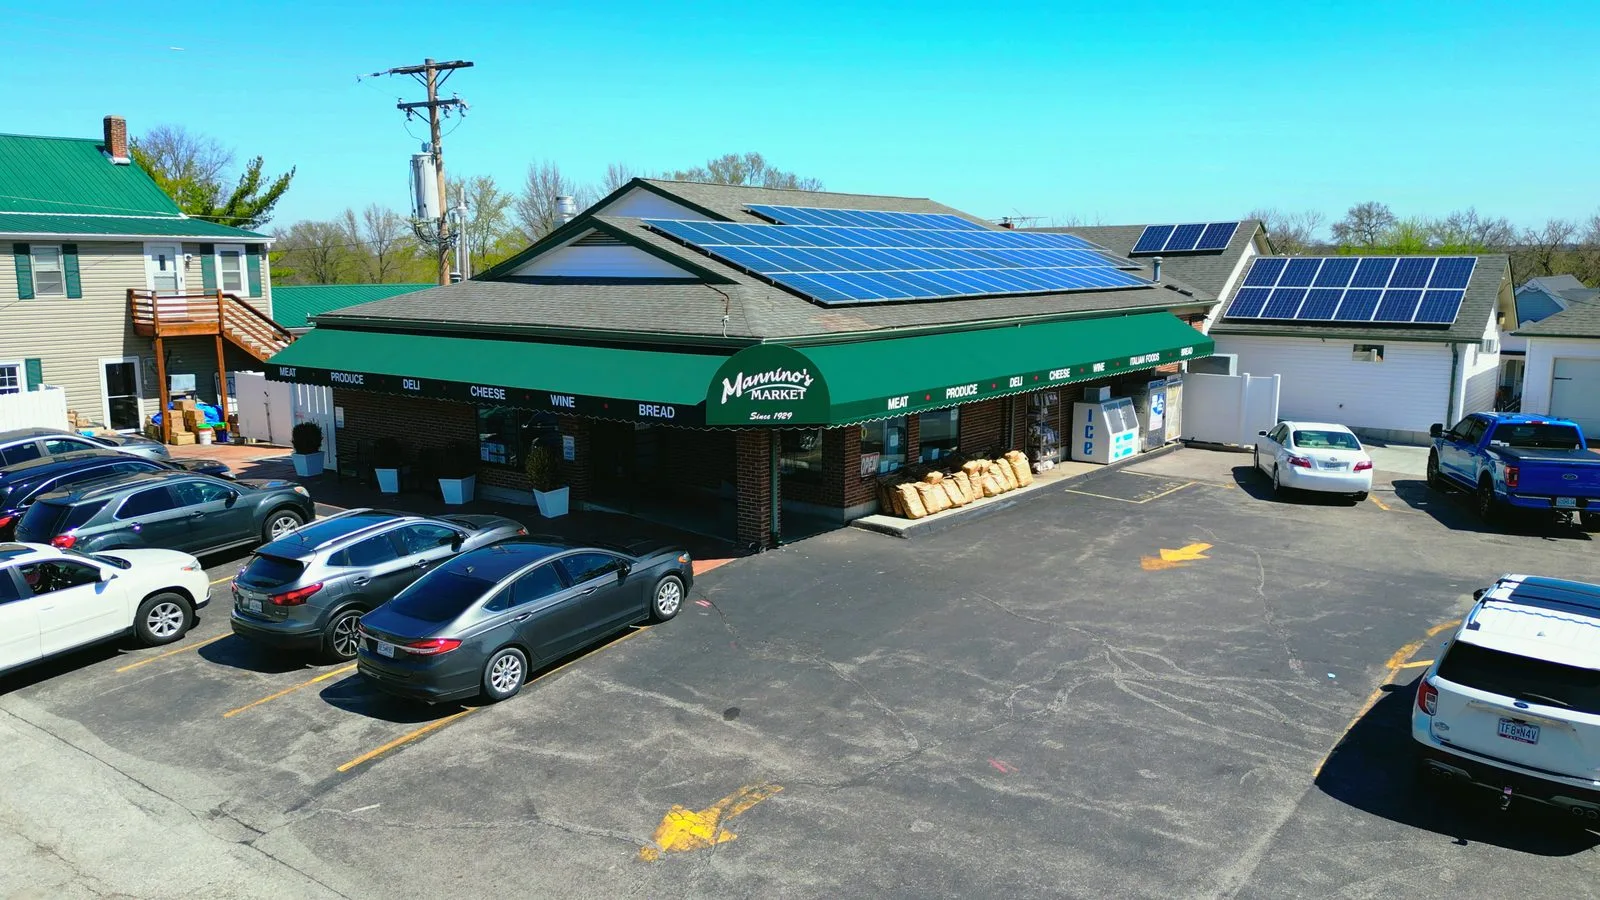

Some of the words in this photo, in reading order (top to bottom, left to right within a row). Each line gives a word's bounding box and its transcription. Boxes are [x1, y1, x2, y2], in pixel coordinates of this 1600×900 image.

[279, 366, 297, 377] MEAT
[330, 371, 364, 385] PRODUCE
[402, 378, 421, 391] DELI
[470, 385, 506, 400] CHEESE
[550, 394, 576, 408] WINE
[638, 403, 675, 419] BREAD
[721, 367, 814, 405] Mannino's
[751, 389, 806, 400] MARKET
[888, 396, 909, 410] MEAT
[946, 384, 978, 399] PRODUCE
[1009, 376, 1023, 388] DELI
[1049, 368, 1071, 380] CHEESE
[1093, 362, 1105, 372] WINE
[1146, 352, 1160, 363] FOODS
[749, 411, 771, 420] Since
[773, 411, 793, 420] 1929
